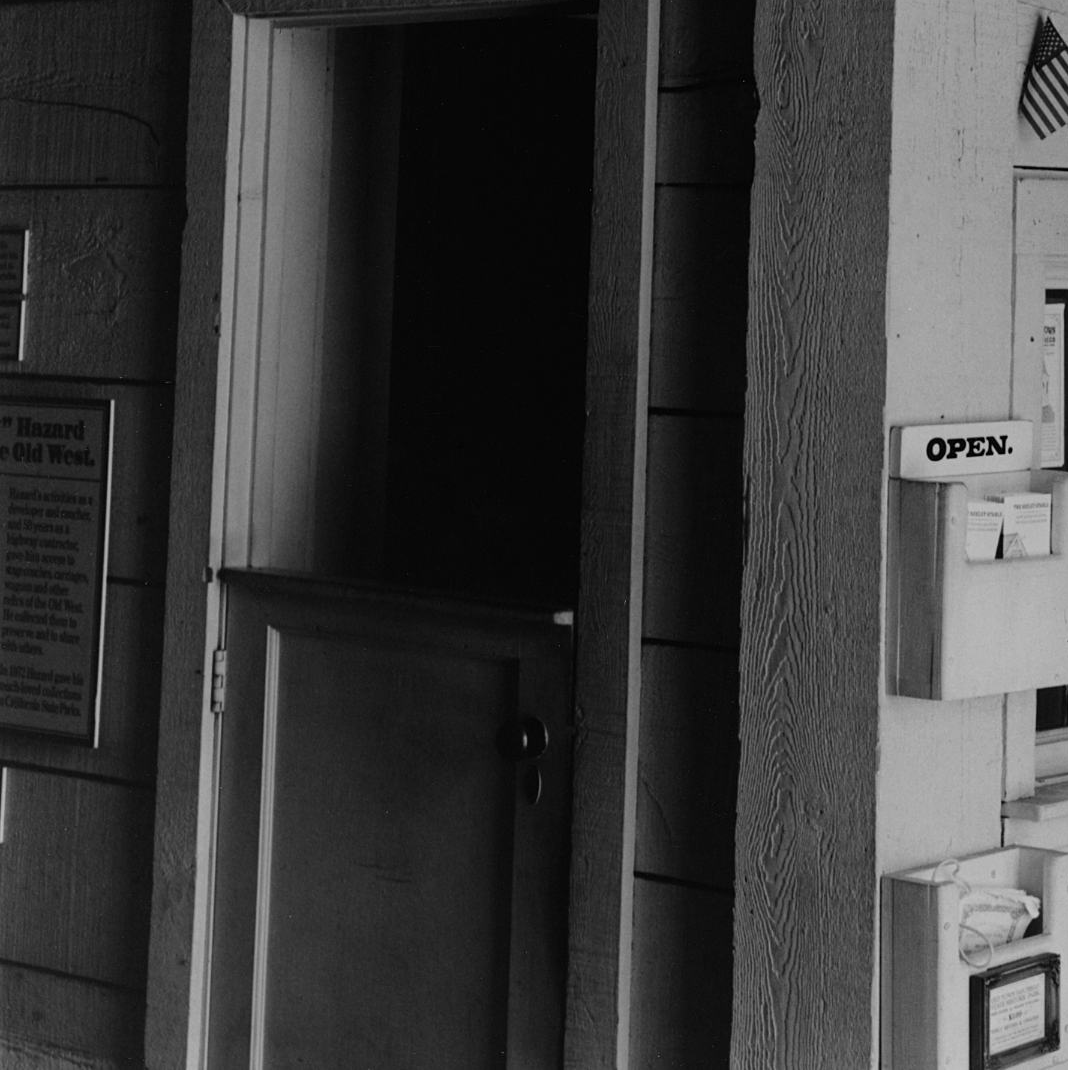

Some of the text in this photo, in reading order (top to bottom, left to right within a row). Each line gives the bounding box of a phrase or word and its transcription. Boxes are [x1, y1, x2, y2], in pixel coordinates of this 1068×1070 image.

[16, 416, 85, 441] Hazard
[12, 441, 43, 465] Old
[47, 444, 96, 468] West.
[926, 435, 1013, 462] OPEN.
